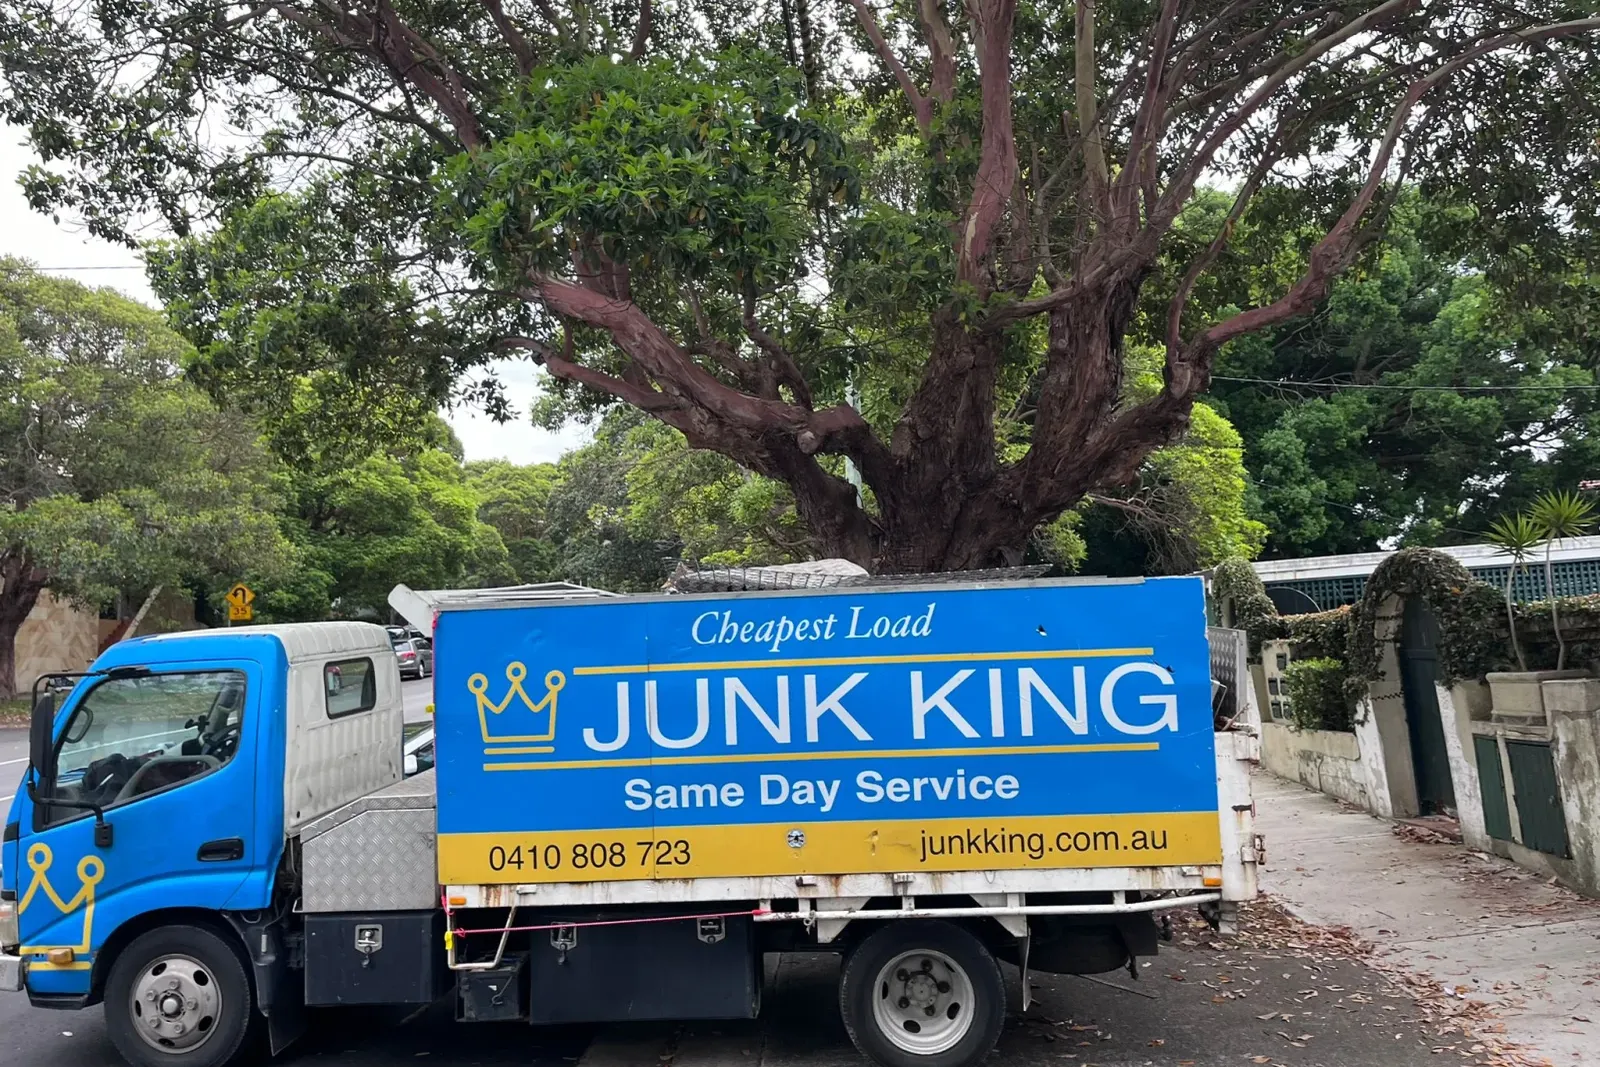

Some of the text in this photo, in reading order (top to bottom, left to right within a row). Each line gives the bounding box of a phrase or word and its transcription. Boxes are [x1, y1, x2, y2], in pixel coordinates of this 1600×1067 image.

[232, 607, 248, 616] 35
[691, 602, 937, 653] Cheapest Load
[582, 661, 1179, 752] JUNK KING
[624, 768, 1020, 813] Same Day Service
[489, 839, 691, 871] 0410 808 723
[919, 827, 1169, 863] junkking.com.au
